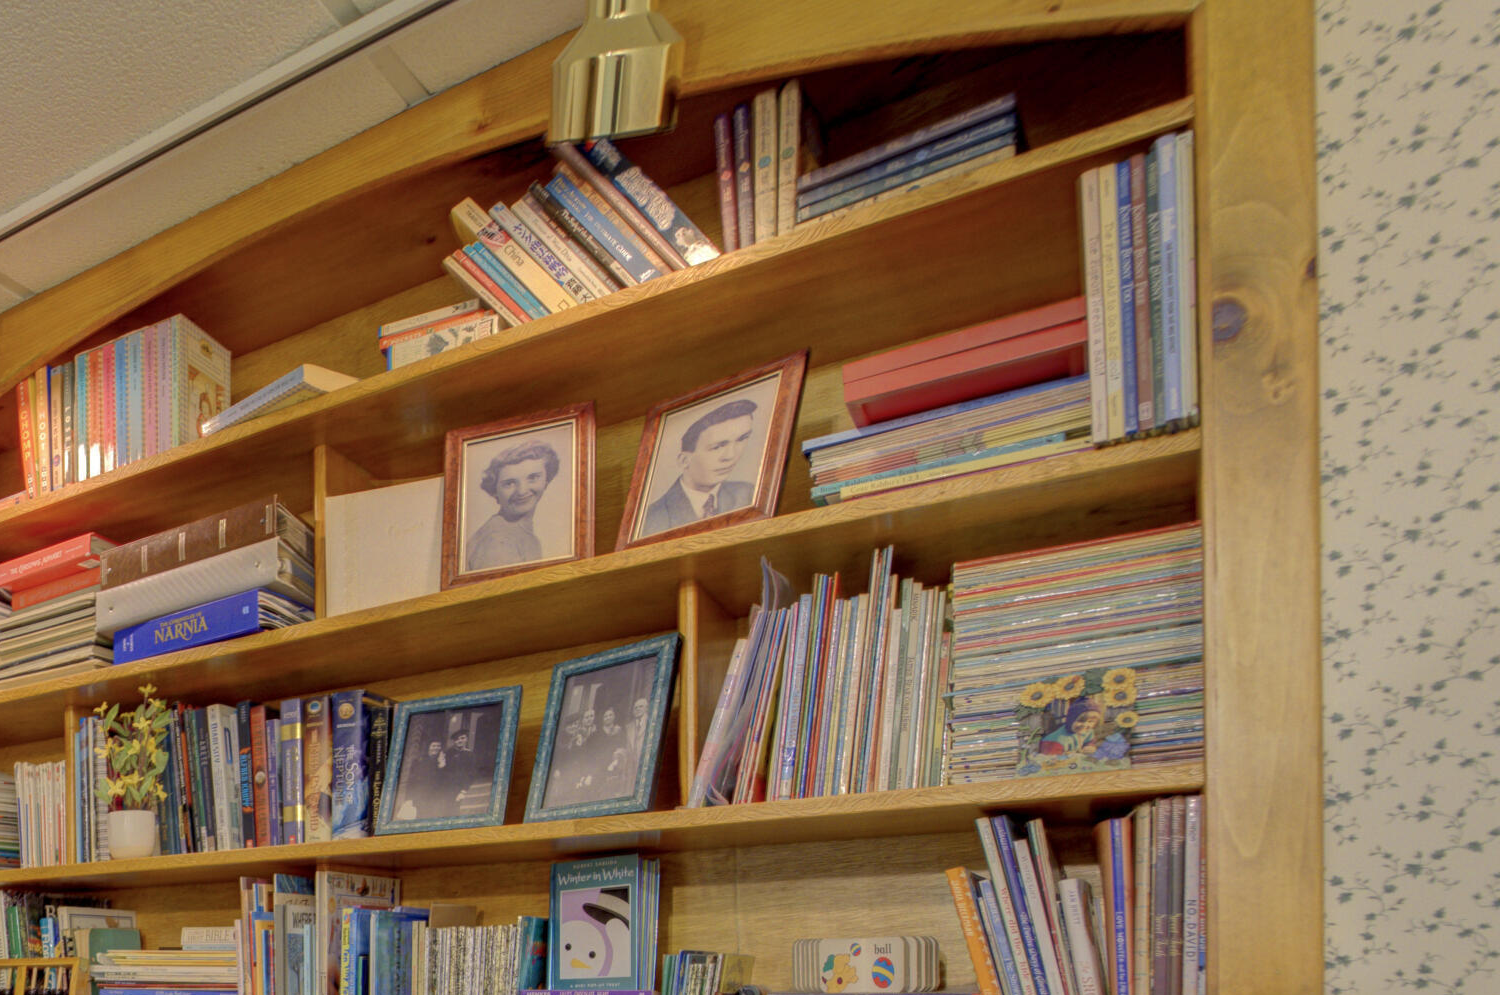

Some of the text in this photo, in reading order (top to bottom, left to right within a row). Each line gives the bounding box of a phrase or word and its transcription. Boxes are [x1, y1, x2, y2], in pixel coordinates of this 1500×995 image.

[503, 244, 525, 268] China
[154, 614, 208, 645] NARNIA
[347, 744, 356, 761] THE
[334, 746, 346, 807] NEPTUNE
[345, 762, 359, 792] SON
[557, 867, 635, 886] Winter in White
[1000, 887, 1015, 915] Where
[1008, 919, 1020, 934] did
[1115, 911, 1125, 962] LOVE MONSTER
[1186, 899, 1197, 963] NO, DAVID!
[874, 943, 892, 954] ball
[1011, 937, 1026, 956] they
[1018, 961, 1032, 980] hide
